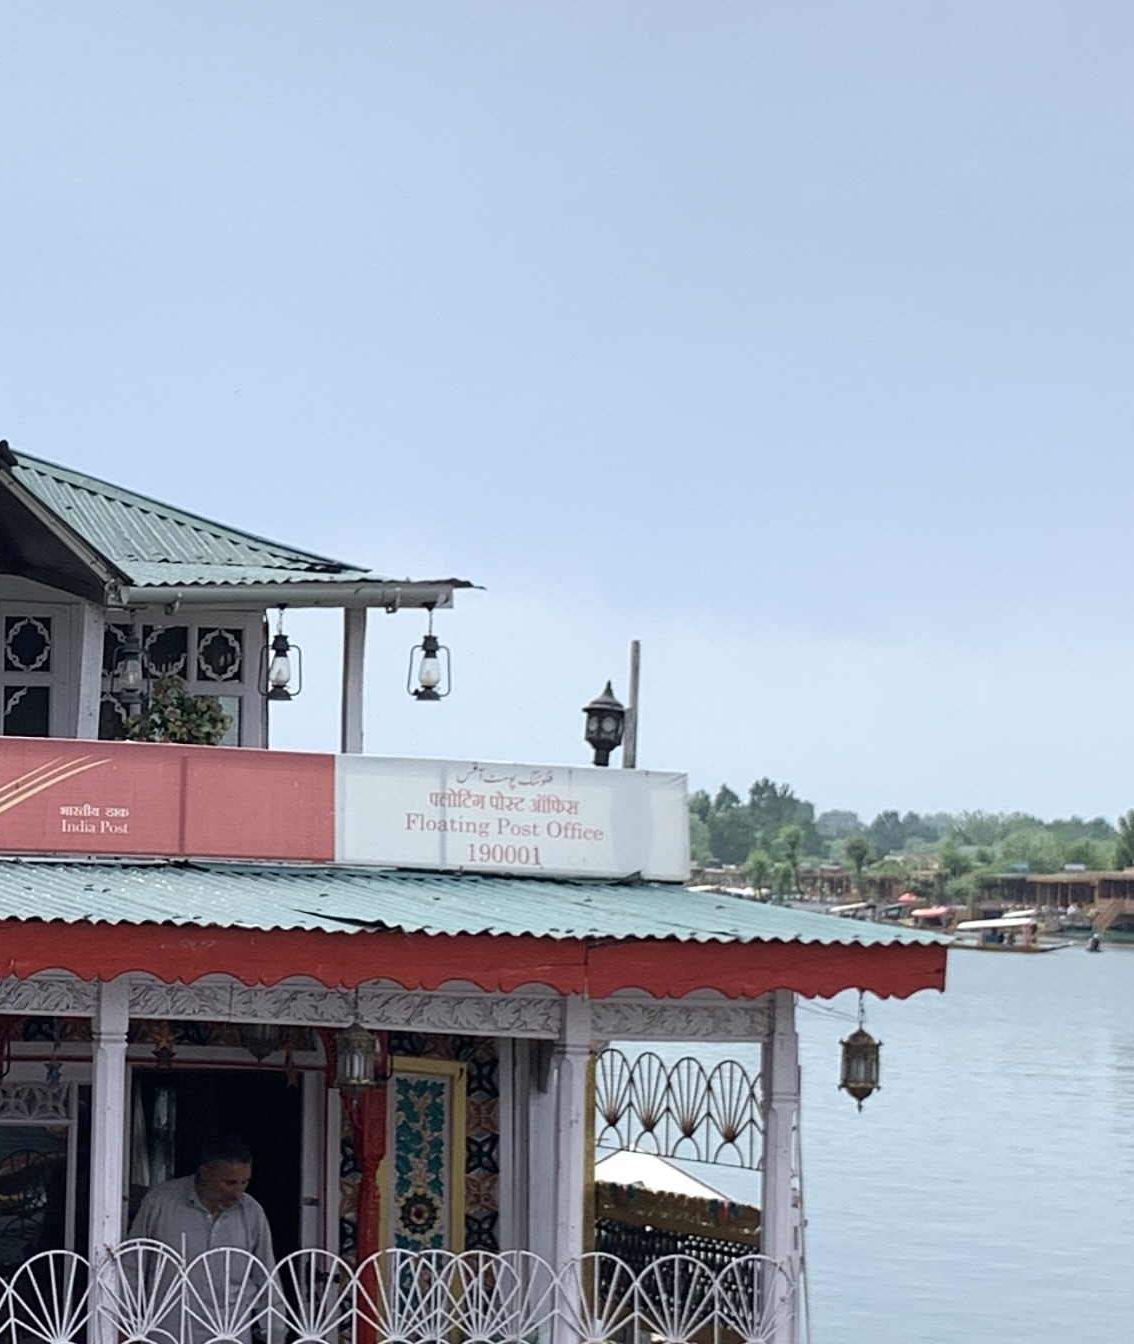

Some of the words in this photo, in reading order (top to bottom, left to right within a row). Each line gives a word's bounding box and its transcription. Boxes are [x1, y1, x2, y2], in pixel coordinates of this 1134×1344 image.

[59, 803, 100, 817] भारतीय
[105, 807, 129, 817] डाक
[490, 791, 525, 812] पोस्ट
[61, 819, 96, 833] India
[100, 820, 129, 834] Post
[405, 812, 490, 838] Floating
[497, 817, 540, 837] Post
[546, 820, 604, 841] Office
[468, 843, 541, 866] 190001
